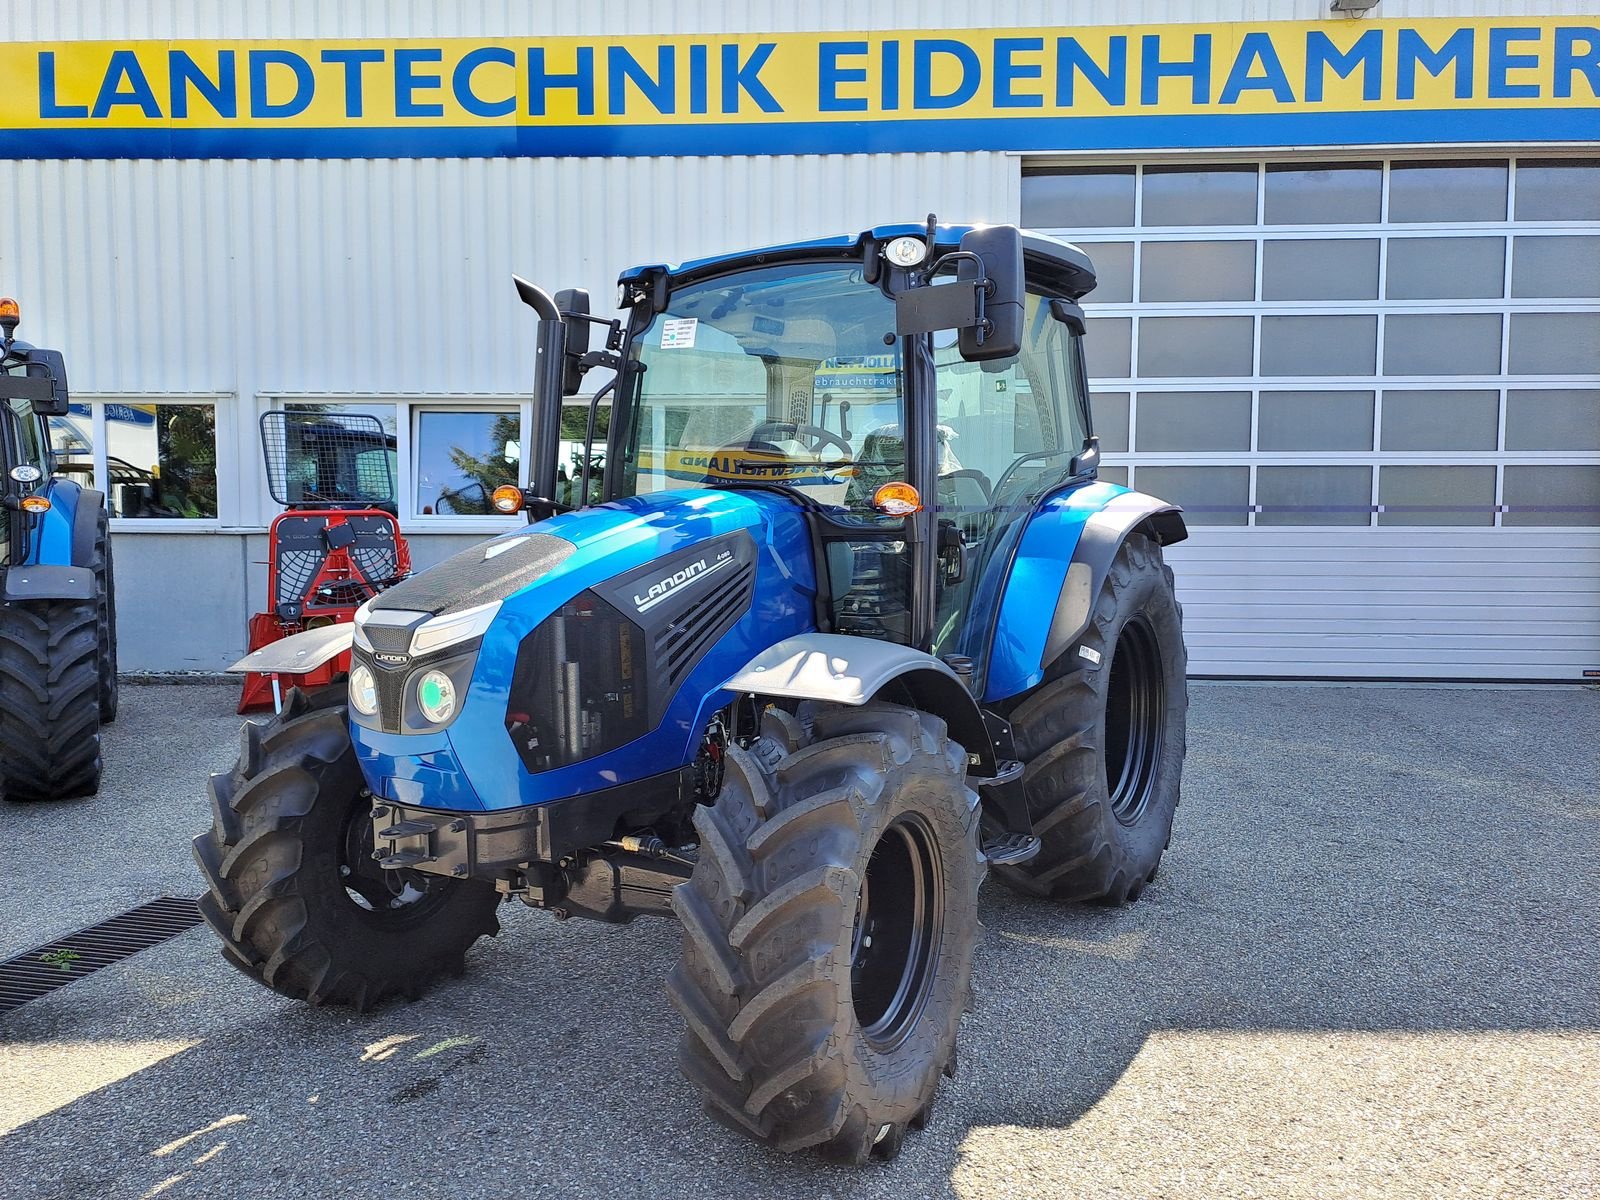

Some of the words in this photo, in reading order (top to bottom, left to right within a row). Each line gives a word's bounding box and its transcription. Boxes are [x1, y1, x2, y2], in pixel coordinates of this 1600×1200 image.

[38, 43, 785, 119] LANDTECHNIK
[817, 27, 1600, 112] EIDENHAMMER
[633, 559, 707, 605] LANDINI
[375, 654, 407, 662] LANDINI
